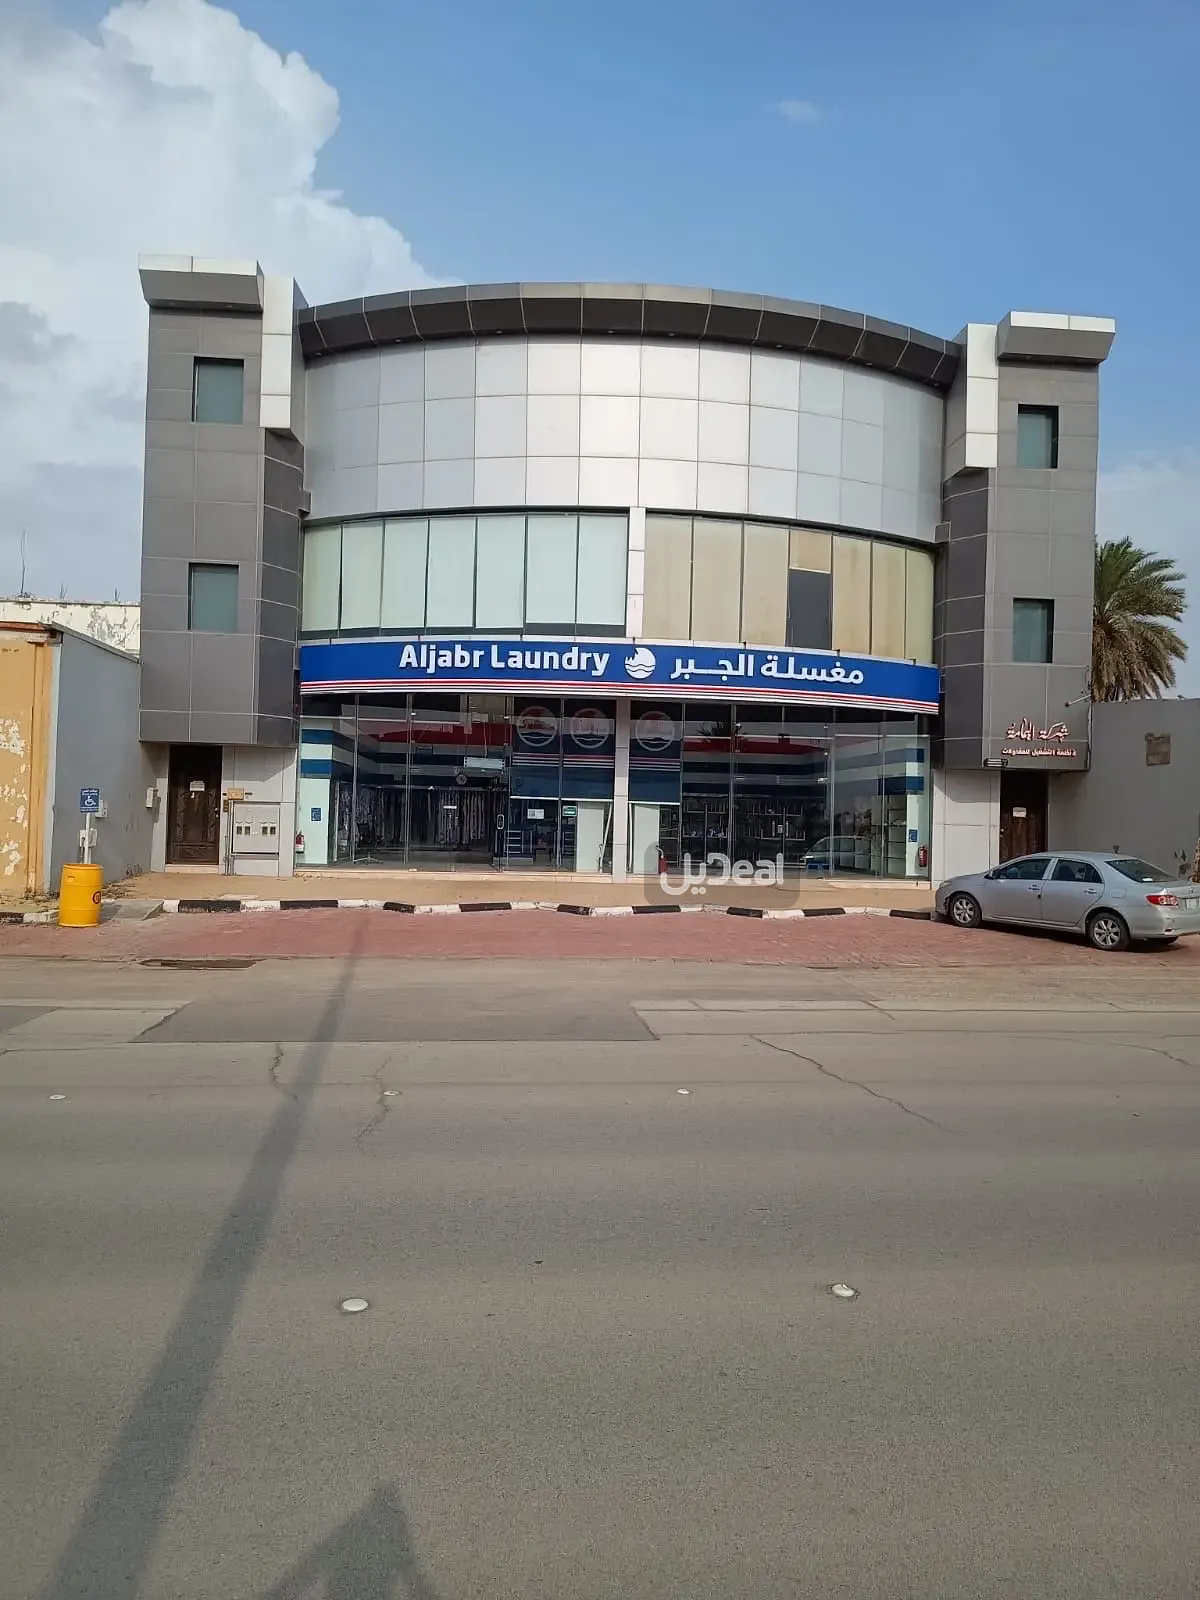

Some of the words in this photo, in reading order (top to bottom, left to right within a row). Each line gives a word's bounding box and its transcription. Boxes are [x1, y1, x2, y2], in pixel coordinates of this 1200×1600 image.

[399, 644, 485, 674] Aljabr
[491, 645, 610, 676] Laundry
[670, 653, 755, 682] الجبر
[760, 654, 865, 685] مغسلة
[1038, 721, 1070, 743] شركة
